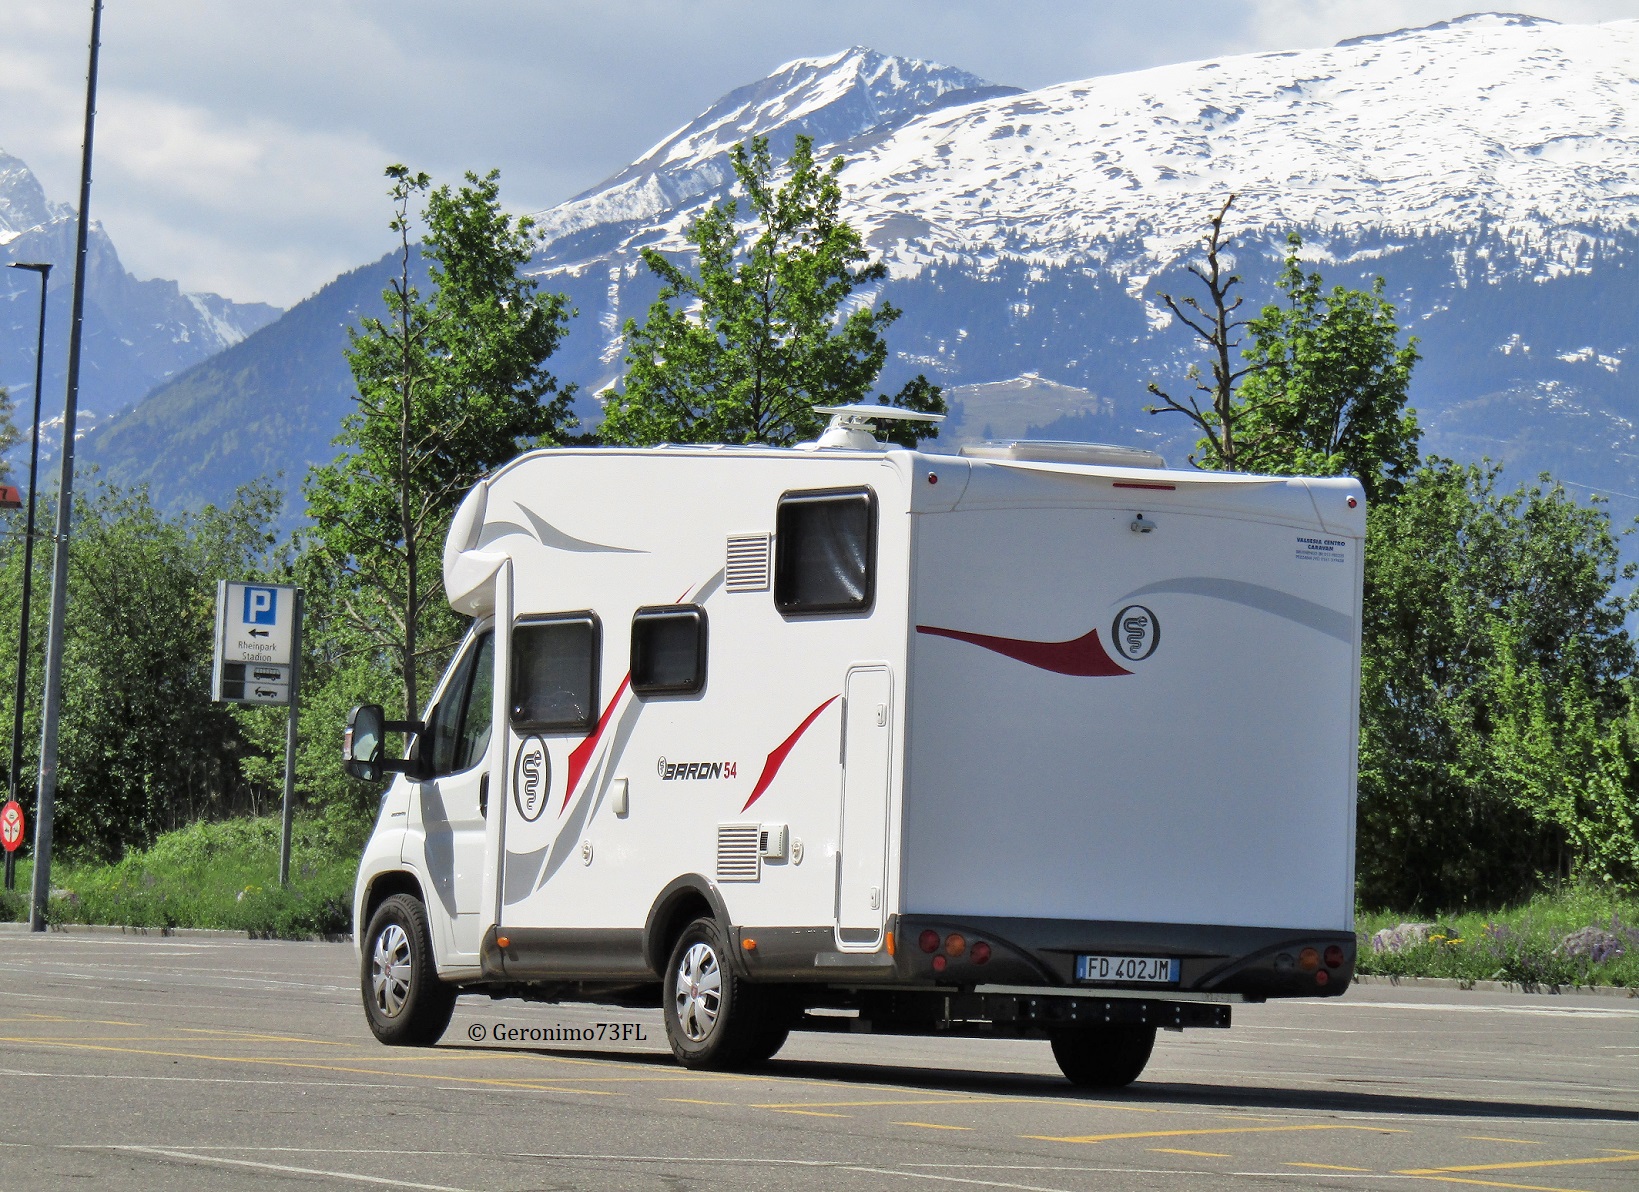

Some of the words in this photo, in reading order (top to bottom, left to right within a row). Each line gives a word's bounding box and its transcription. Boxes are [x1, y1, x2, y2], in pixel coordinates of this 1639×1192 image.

[249, 589, 271, 623] P
[238, 640, 277, 652] Rheinpark
[242, 651, 272, 662] Stadion
[662, 762, 723, 780] BARON
[723, 761, 737, 779] 54
[1115, 959, 1169, 980] 402JM
